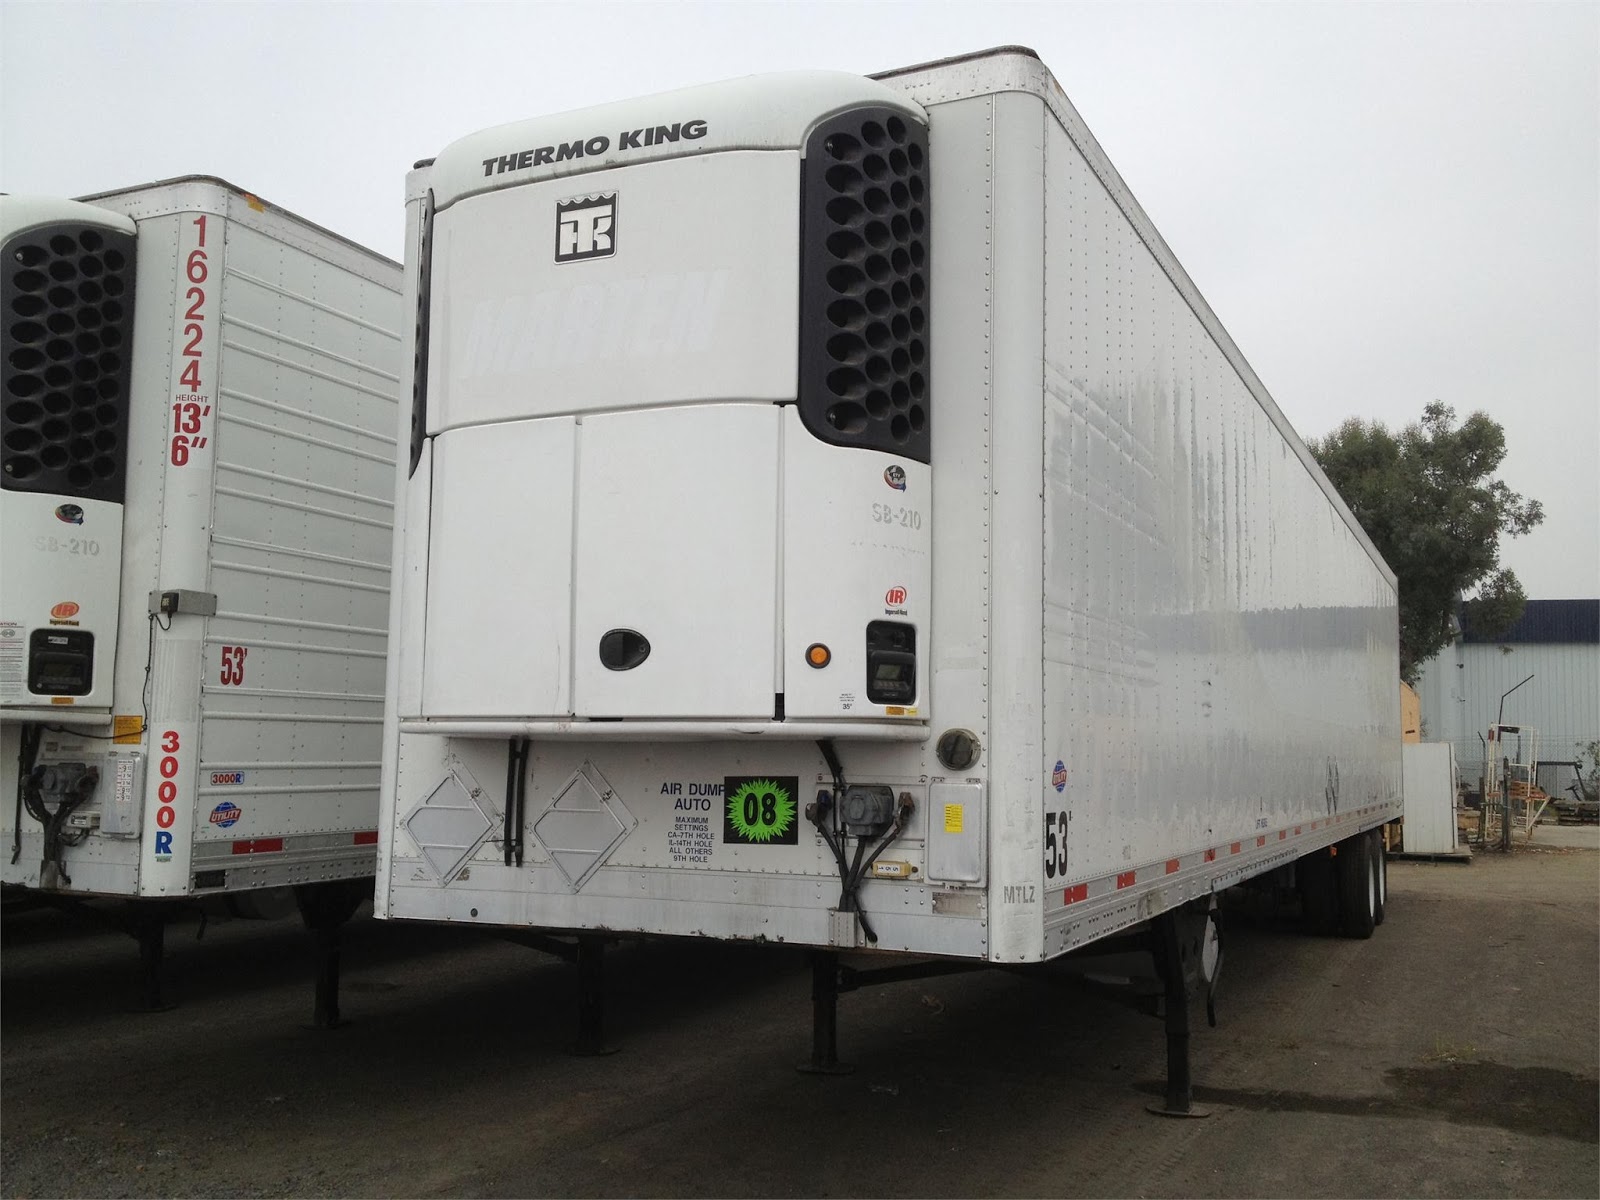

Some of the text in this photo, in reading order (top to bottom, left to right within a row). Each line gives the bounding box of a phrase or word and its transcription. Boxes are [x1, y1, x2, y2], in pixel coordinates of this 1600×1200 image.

[482, 119, 708, 177] THERMO KING
[175, 394, 209, 403] HEIGHT
[172, 402, 211, 434] 13'
[872, 502, 922, 531] SB-210
[34, 536, 100, 556] SB-210
[889, 589, 904, 604] IR
[219, 646, 248, 686] 53'
[212, 773, 242, 784] 3000R
[660, 782, 682, 795] AIR
[674, 798, 711, 811] AUTO
[743, 792, 777, 827] 08
[210, 809, 241, 823] UTILITY
[675, 816, 709, 824] MAXIMUM
[674, 823, 709, 832] SETTINGS
[667, 831, 715, 840] CA-7TH HOLE
[694, 840, 713, 848] HOLE
[1045, 810, 1072, 879] 53'
[685, 847, 713, 856] OTHERS
[689, 855, 708, 863] HOLE
[1003, 885, 1036, 904] MTLZ
